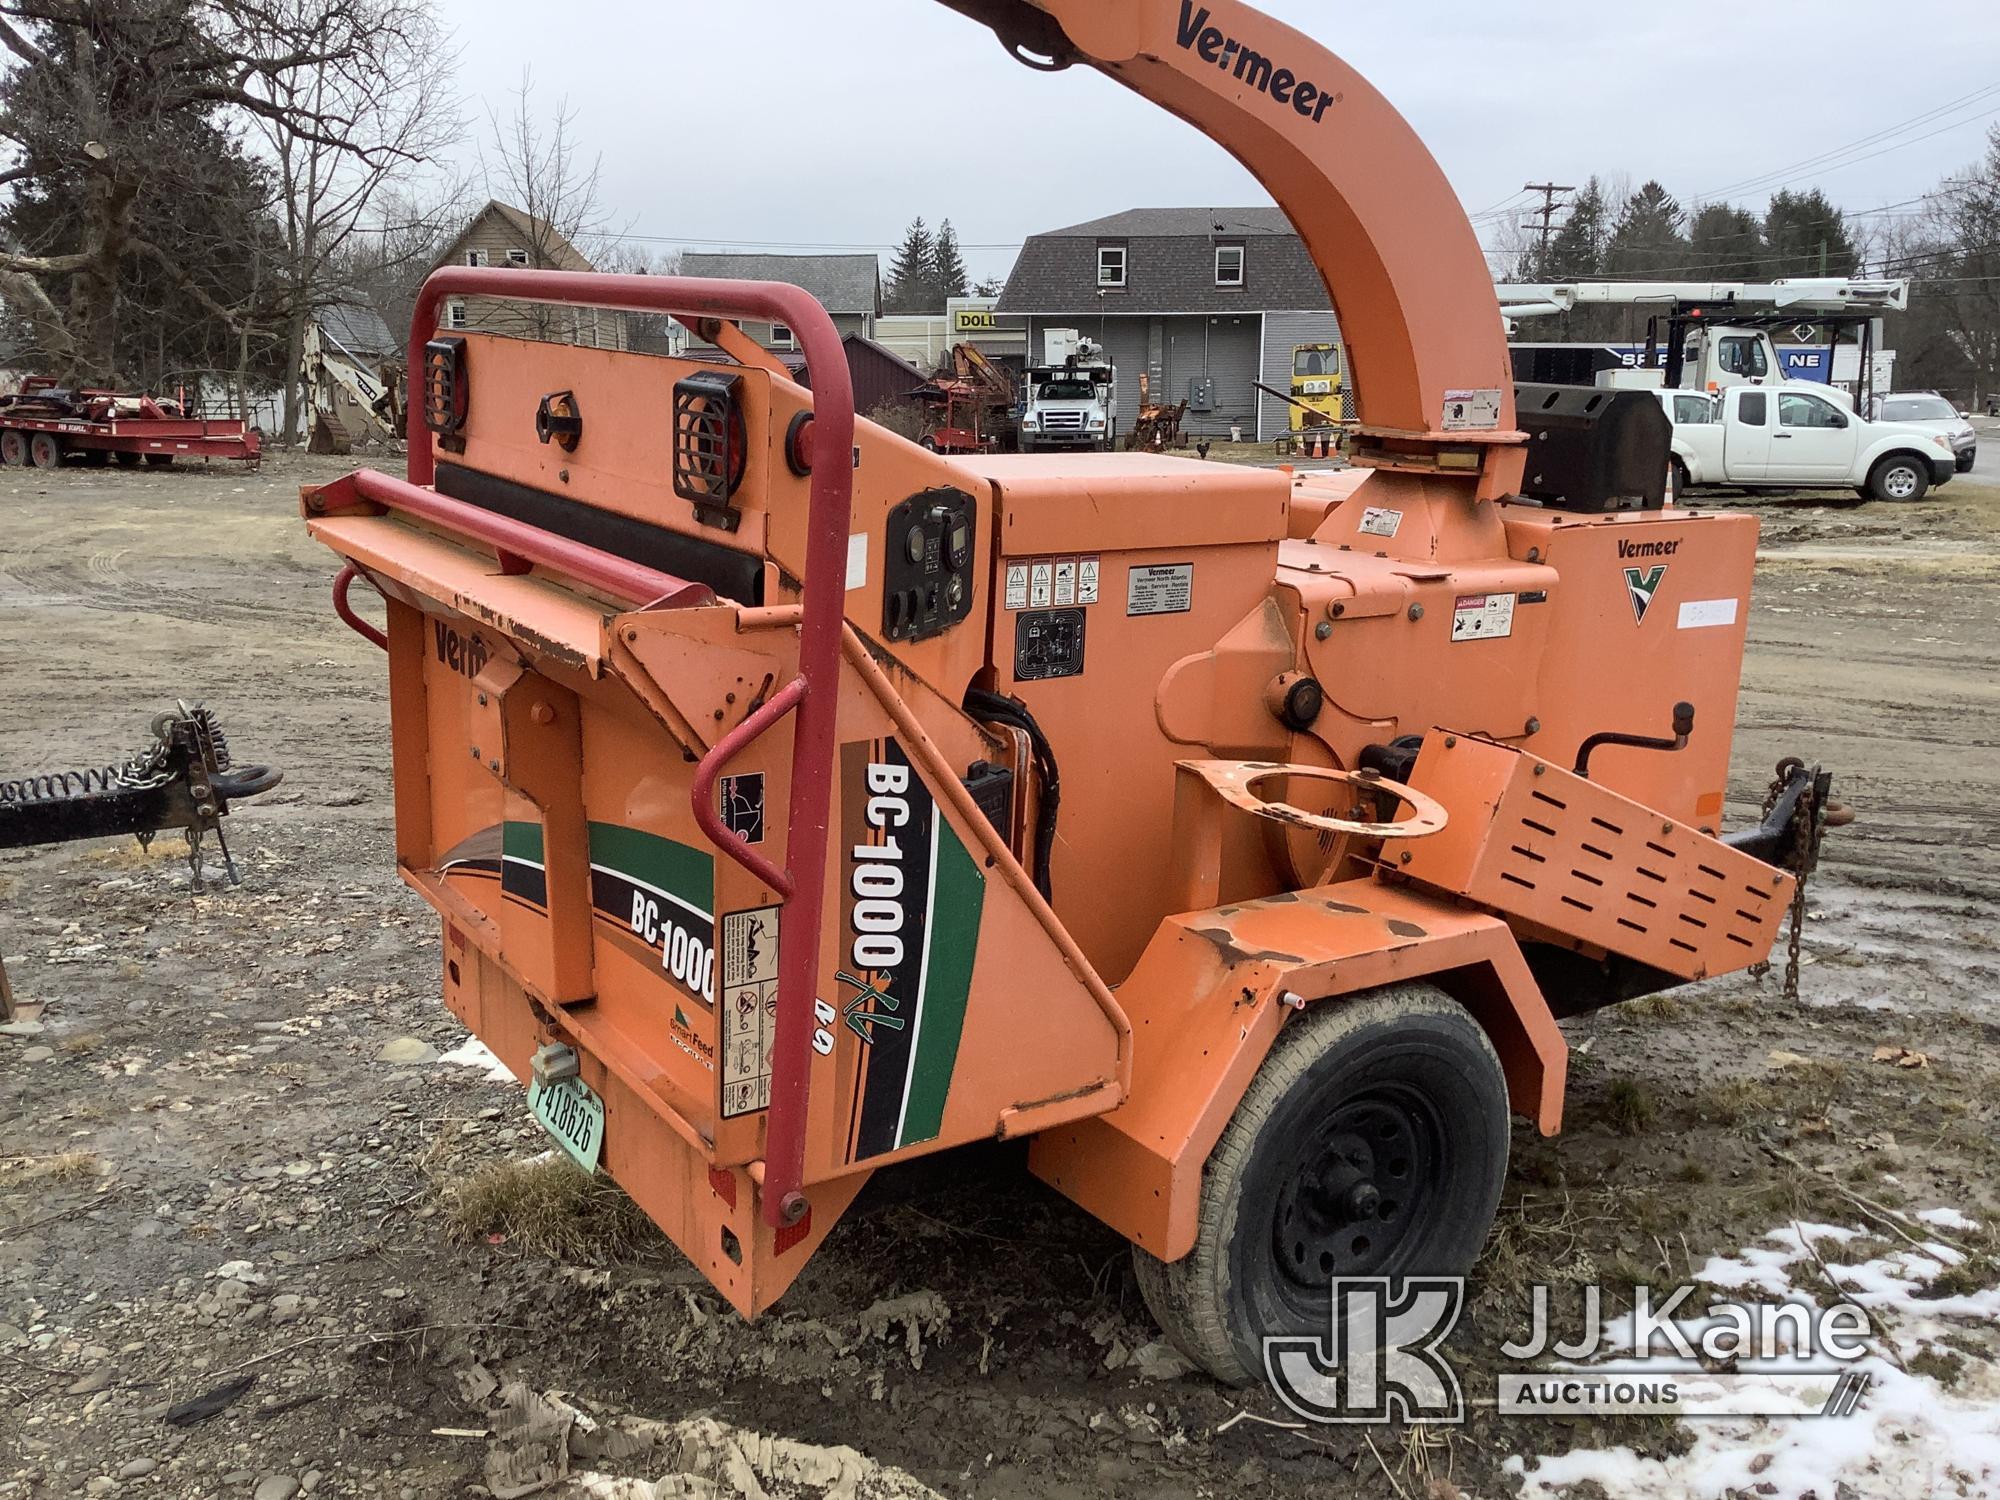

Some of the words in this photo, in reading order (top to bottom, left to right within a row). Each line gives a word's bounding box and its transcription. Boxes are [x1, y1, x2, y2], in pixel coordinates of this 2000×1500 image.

[1177, 0, 1334, 123] Vermeer
[1789, 354, 1820, 367] NE
[1618, 538, 1680, 558] Vermeer
[1148, 568, 1176, 576] Vermeer
[1462, 598, 1485, 606] DANGER
[434, 619, 487, 679] Verm
